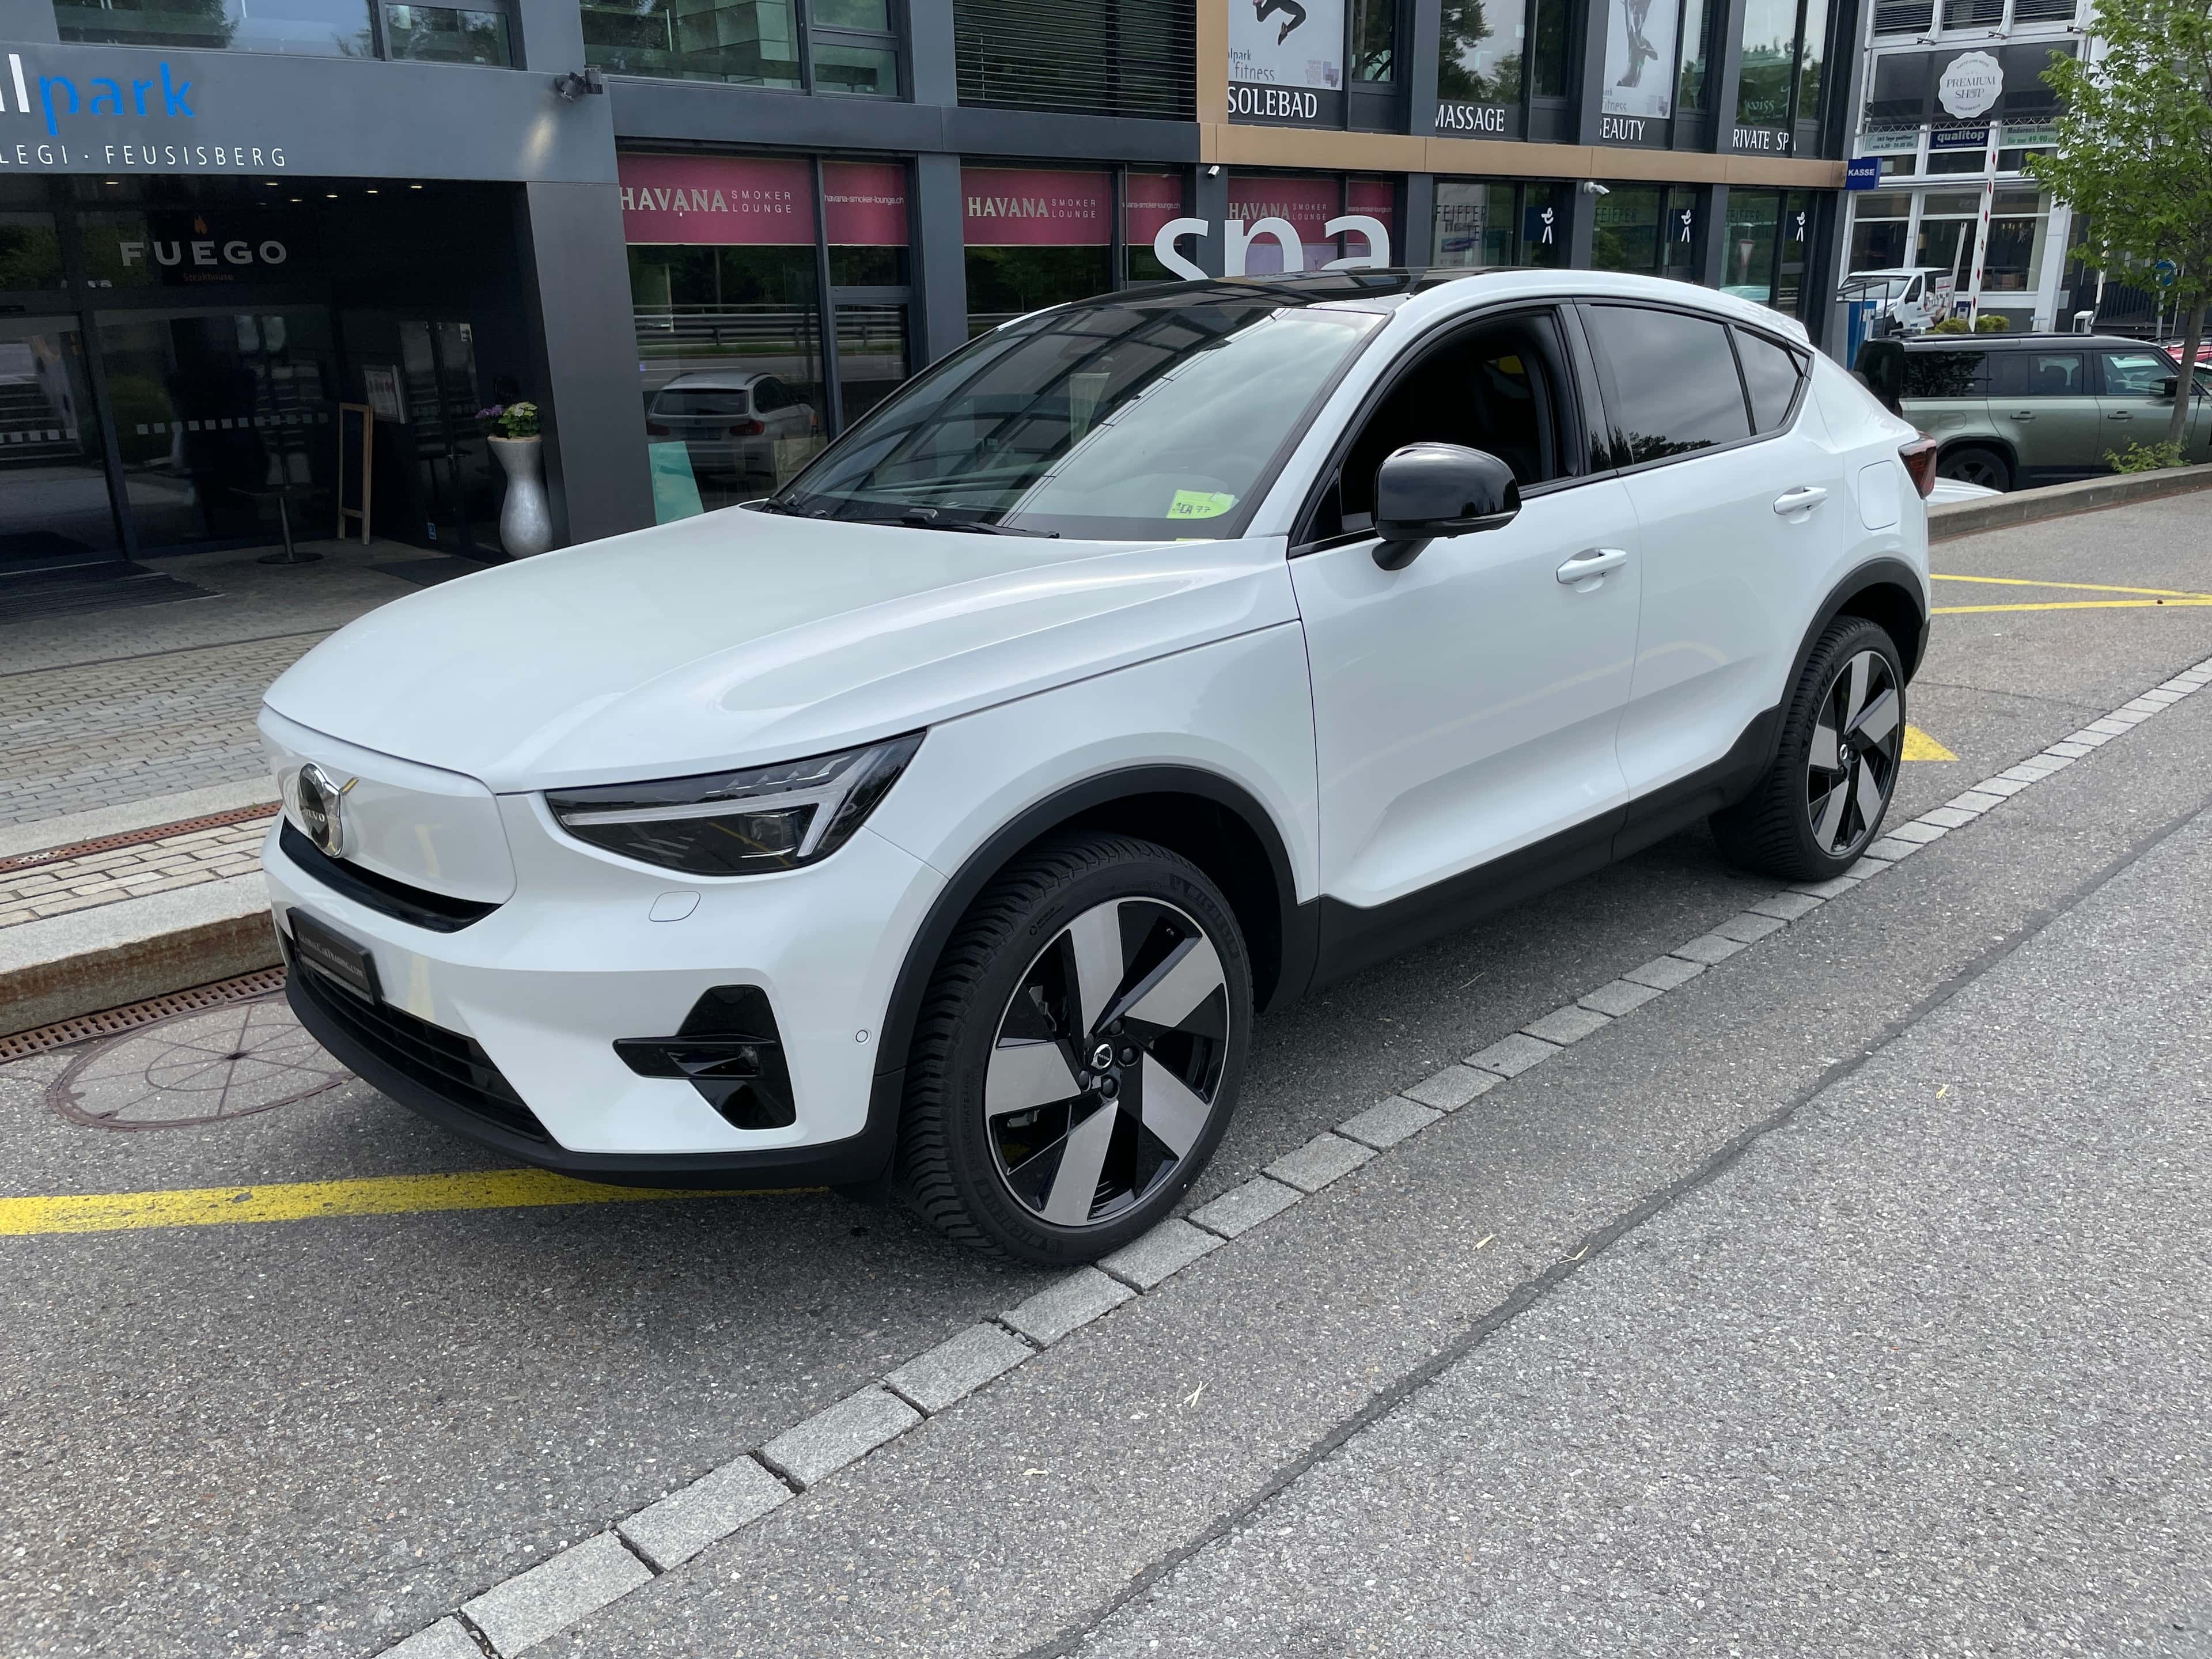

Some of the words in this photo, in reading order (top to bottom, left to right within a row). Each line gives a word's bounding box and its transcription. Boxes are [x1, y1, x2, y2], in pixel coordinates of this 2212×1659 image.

[1235, 62, 1275, 82] fitness
[1946, 76, 1995, 88] PREMIUM
[1228, 86, 1317, 119] SOLEBAD
[1955, 88, 1984, 99] SHOP
[1435, 104, 1505, 132] MASSAGE
[1600, 118, 1645, 141] EAUTY
[1937, 130, 1985, 143] qualitop
[105, 145, 286, 166] FEUSISBERG
[619, 187, 729, 212] HAVANA
[732, 190, 791, 200] SMOKER
[732, 203, 792, 213] LOUNGE
[824, 194, 904, 206] havana-smoker-lounge.ch
[967, 197, 1049, 218] HAVANA
[1051, 199, 1096, 207] SMOKER
[1052, 210, 1096, 218] LOUNGE
[1229, 203, 1290, 220] HAVANA
[119, 240, 287, 267] FUEGO
